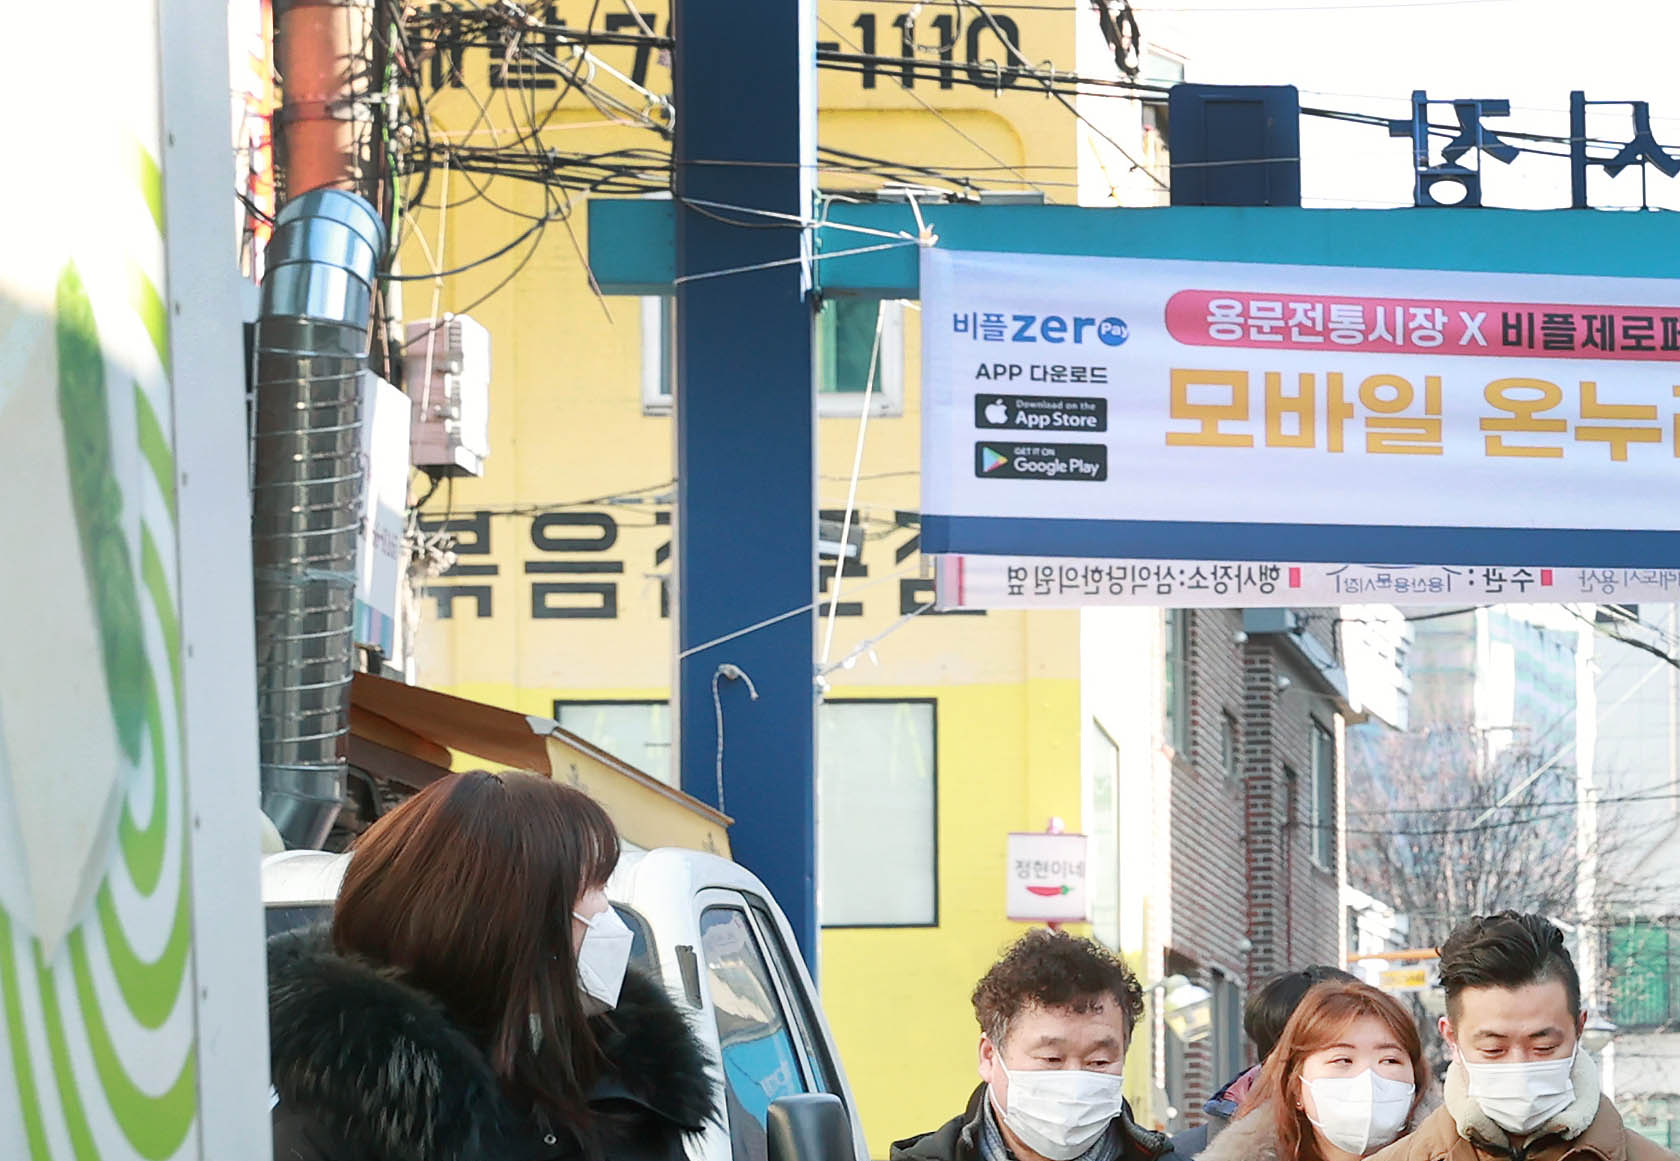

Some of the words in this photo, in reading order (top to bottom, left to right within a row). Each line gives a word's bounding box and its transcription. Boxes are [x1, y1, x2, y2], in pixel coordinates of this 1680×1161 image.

[1206, 298, 1448, 347] 용문전통시장
[1459, 311, 1488, 346] X
[975, 363, 1023, 381] APP
[1030, 364, 1108, 384] 다운로드
[1015, 399, 1063, 410] Download
[1066, 402, 1078, 410] on
[1080, 401, 1097, 410] the
[1165, 367, 1444, 456] 모바일
[1015, 410, 1051, 428] App
[1052, 412, 1098, 427] Store
[1014, 447, 1032, 456] GET
[1041, 447, 1056, 456] ON
[1013, 457, 1067, 476] Google
[1069, 458, 1100, 477] Play
